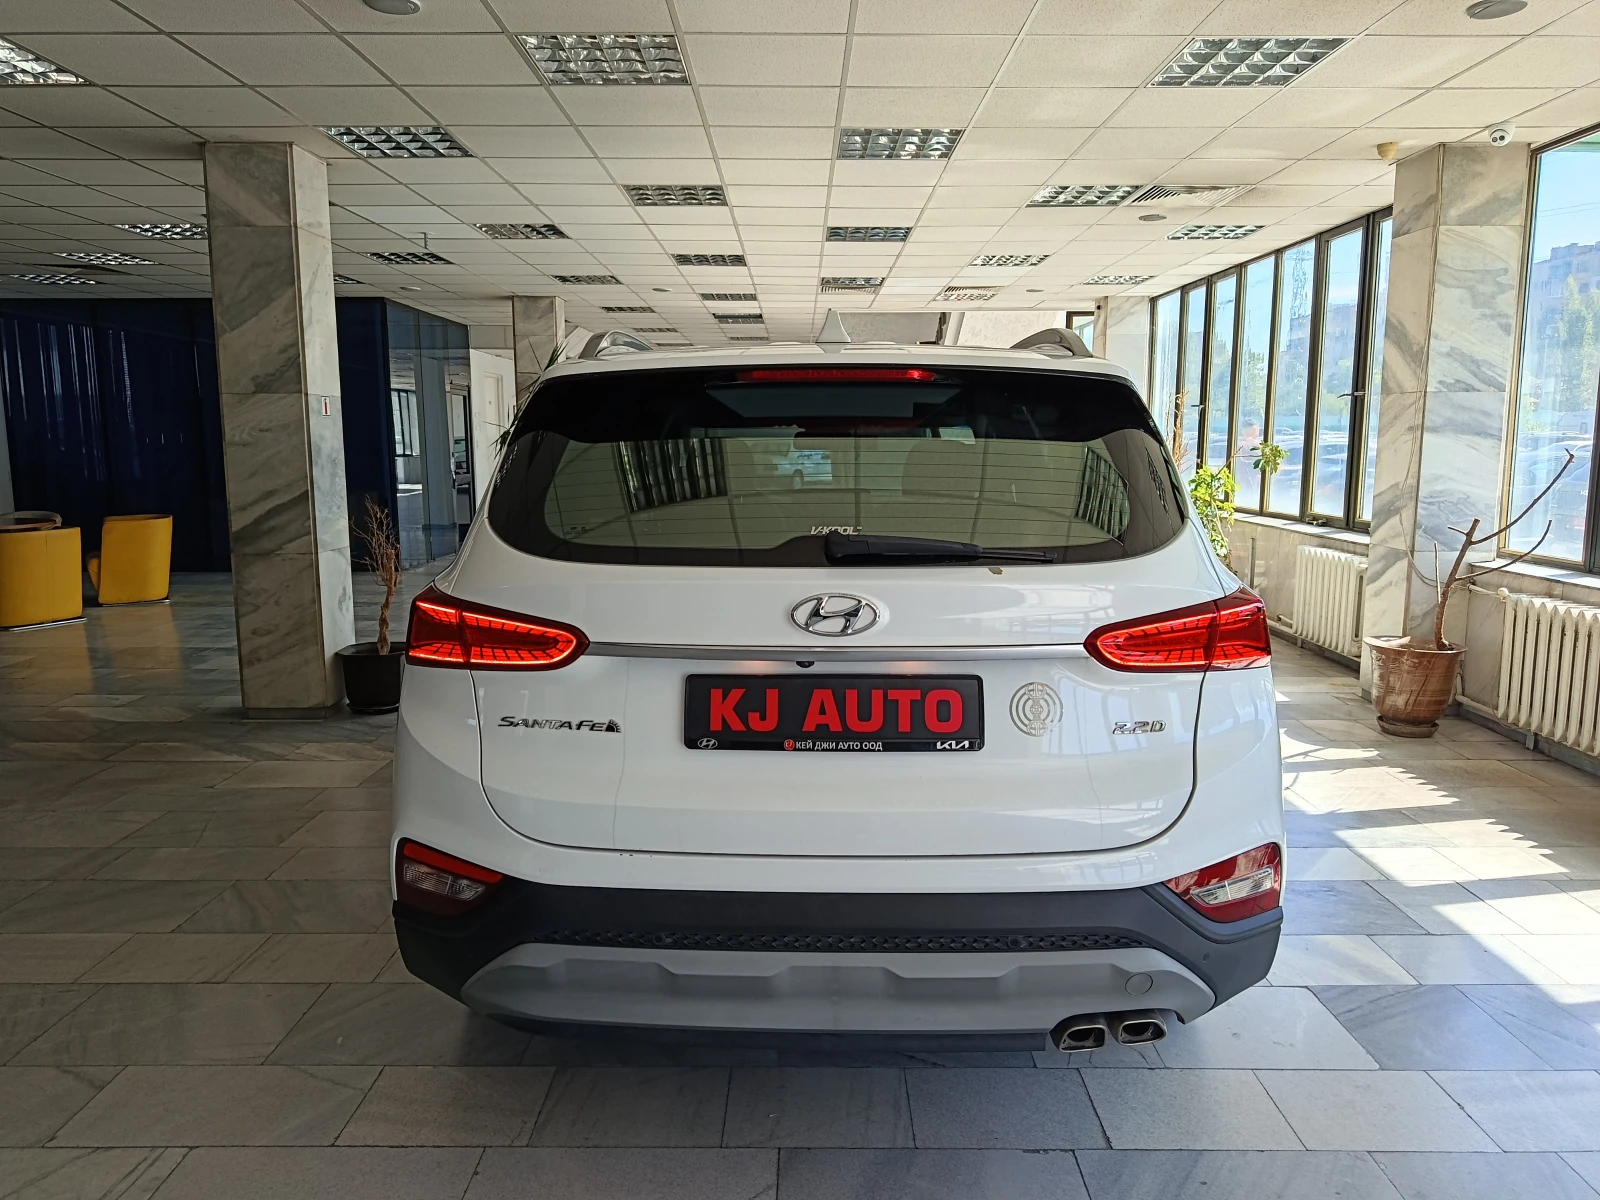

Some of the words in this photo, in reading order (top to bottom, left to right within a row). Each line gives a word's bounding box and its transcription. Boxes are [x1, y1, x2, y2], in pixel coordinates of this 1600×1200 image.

[709, 688, 779, 732] KJ
[802, 688, 963, 733] AUTO
[795, 740, 813, 749] КЕЙ
[814, 741, 836, 751] ДЖИ
[837, 741, 860, 750] АУТО
[862, 741, 882, 751] ООД
